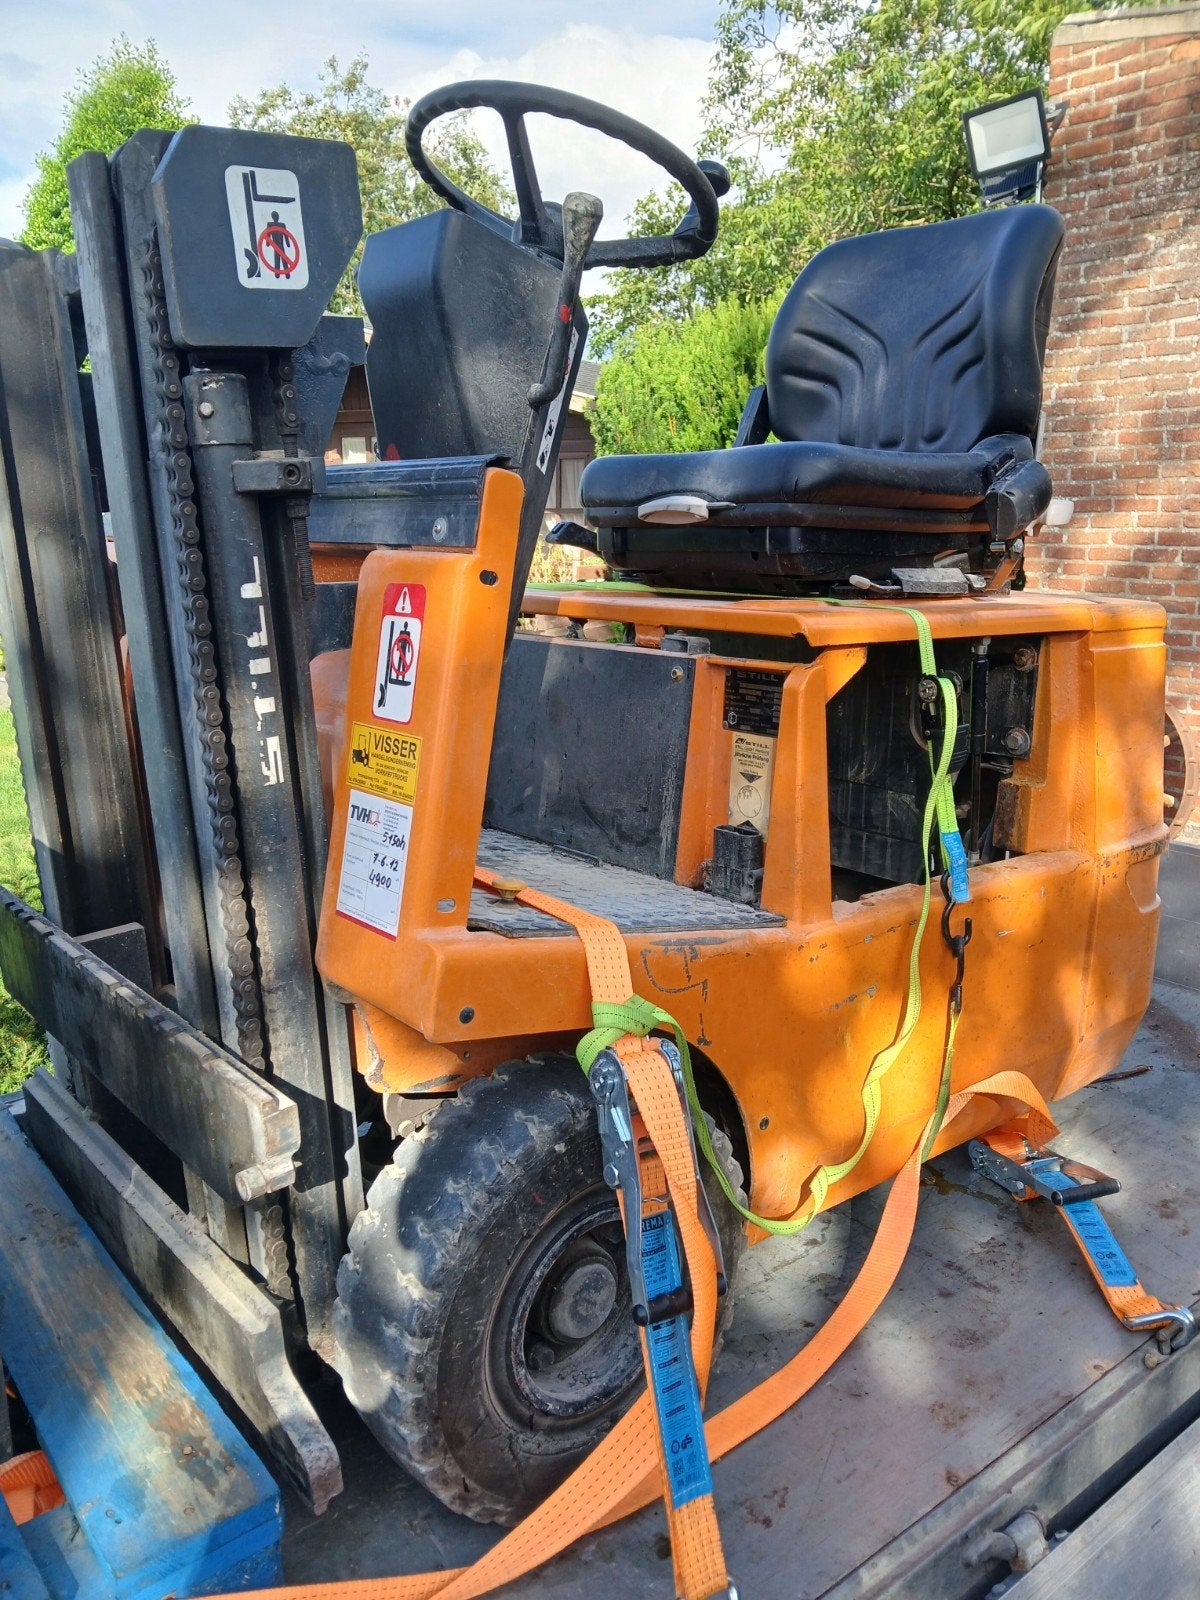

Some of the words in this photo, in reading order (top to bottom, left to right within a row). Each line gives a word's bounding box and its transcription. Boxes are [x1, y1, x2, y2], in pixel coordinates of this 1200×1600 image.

[374, 733, 418, 760] VISSER
[350, 804, 372, 824] TVH
[368, 869, 392, 888] 4900
